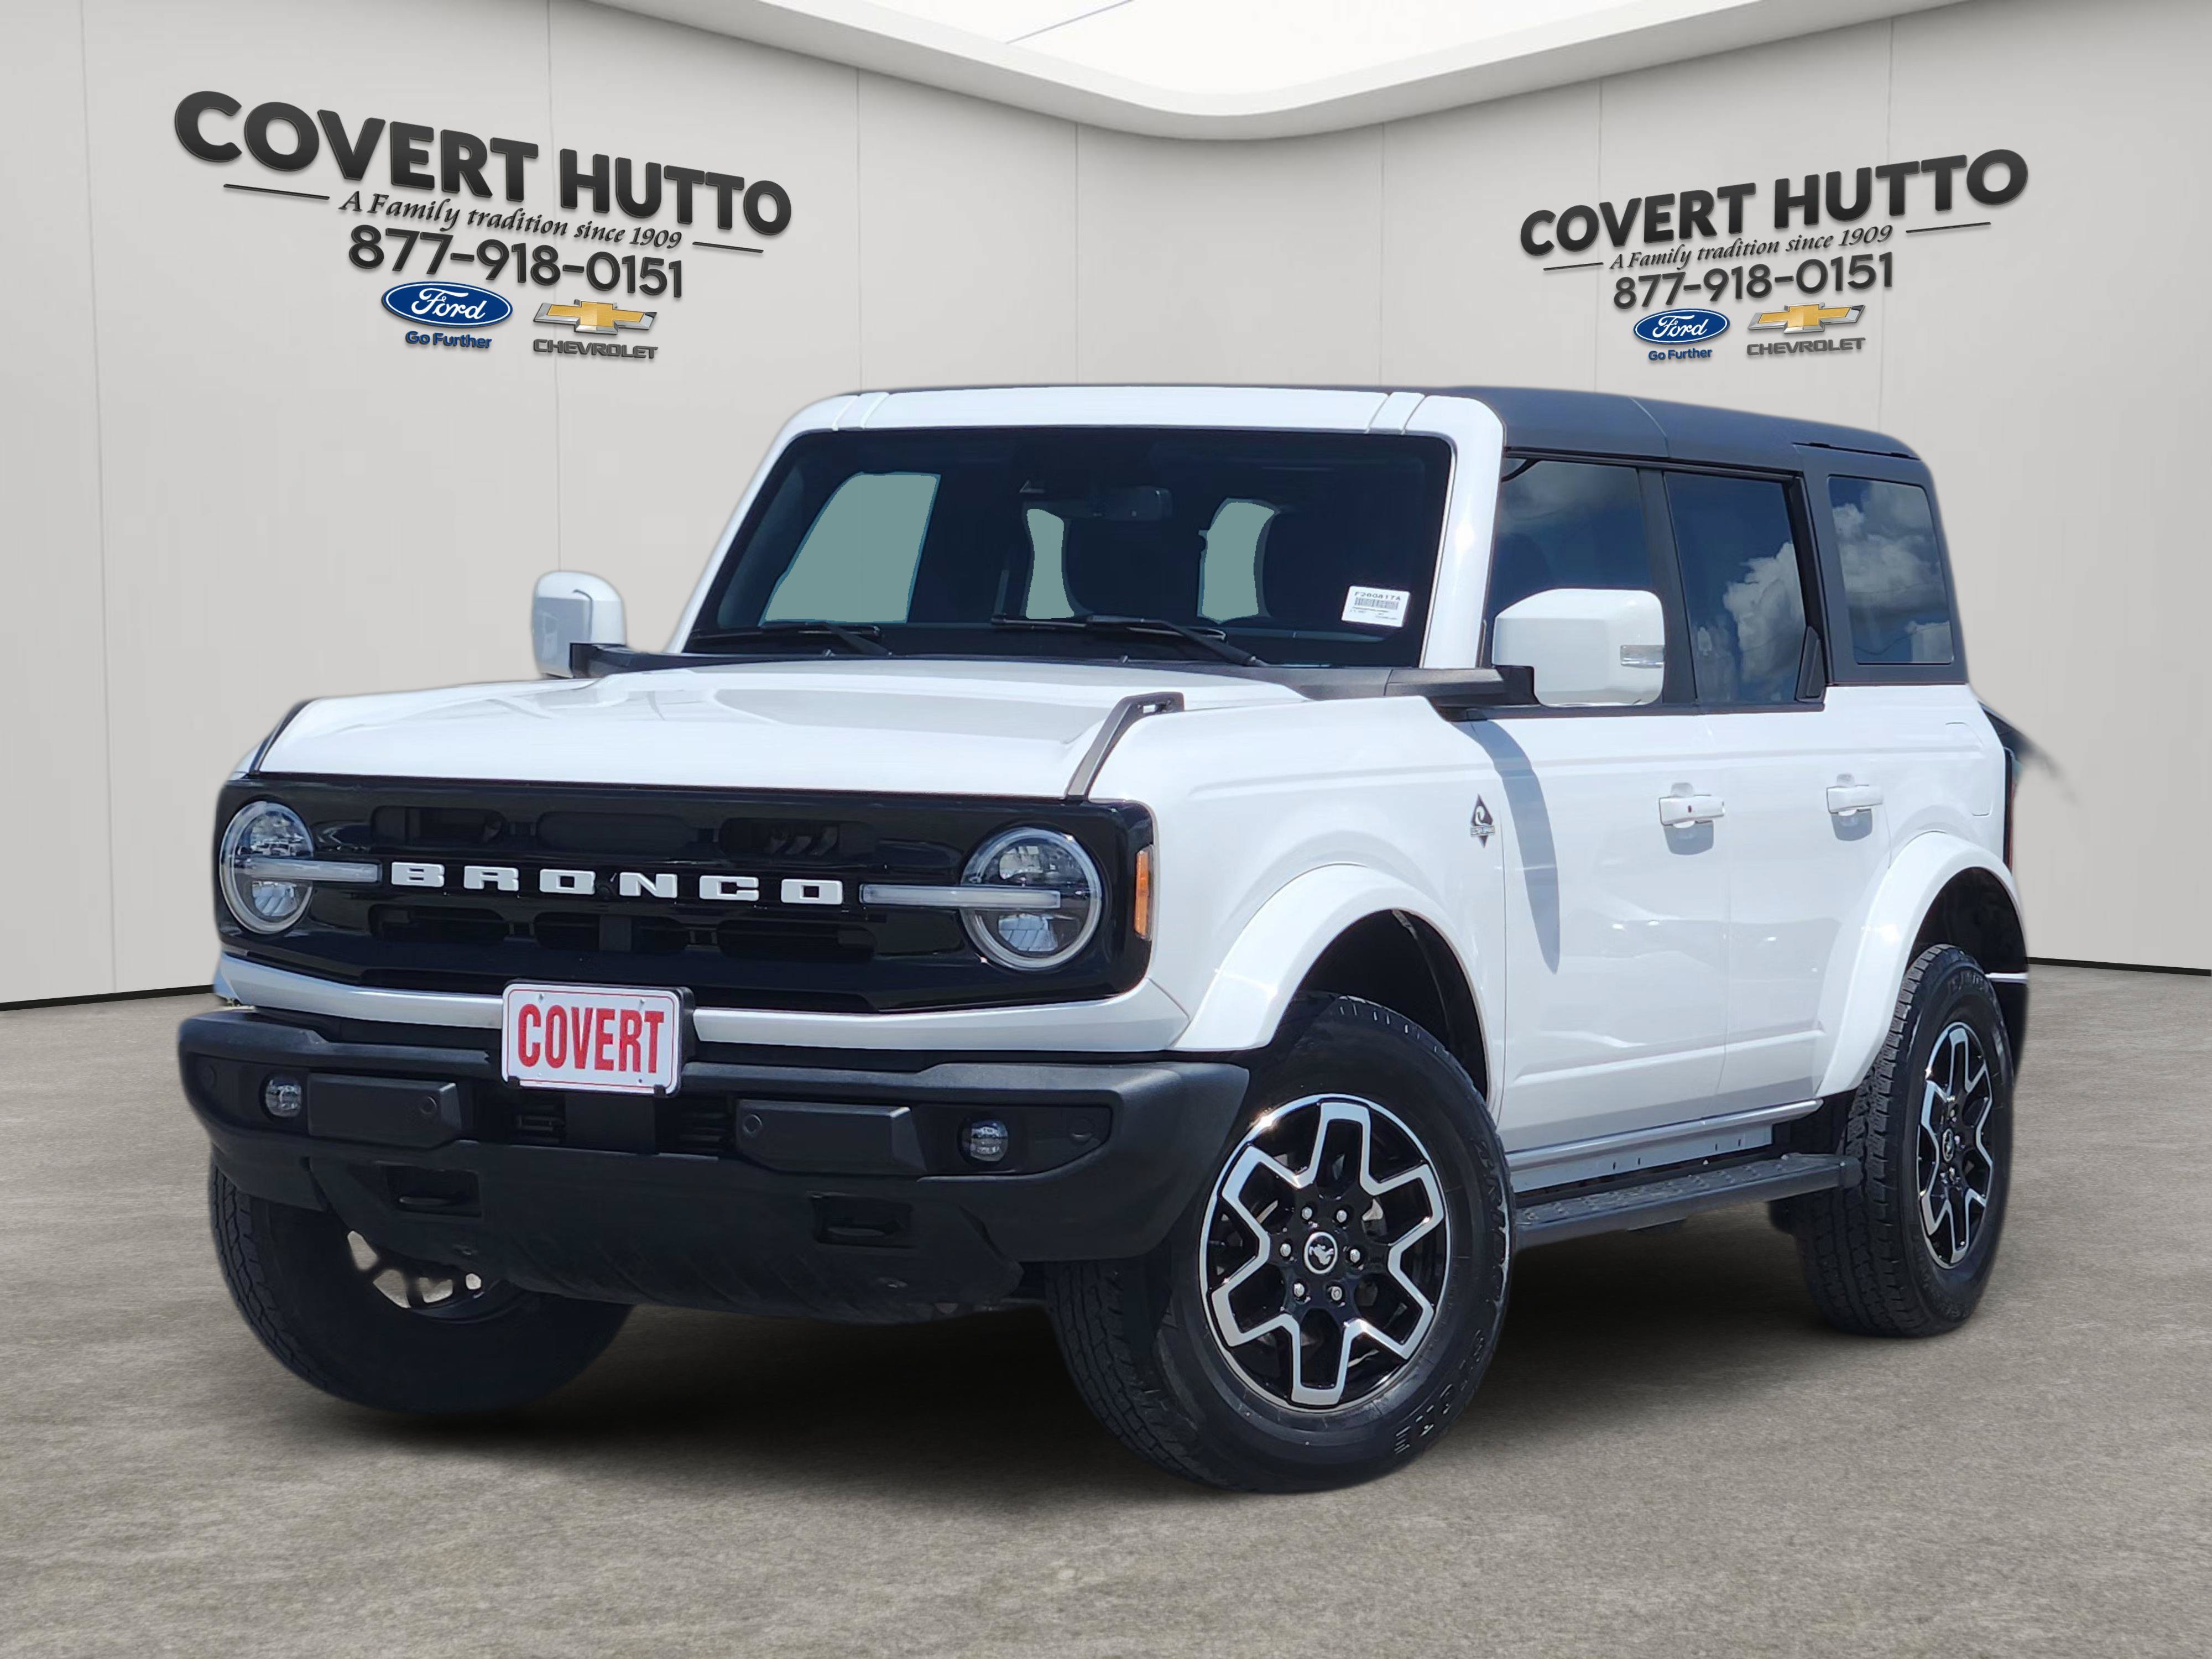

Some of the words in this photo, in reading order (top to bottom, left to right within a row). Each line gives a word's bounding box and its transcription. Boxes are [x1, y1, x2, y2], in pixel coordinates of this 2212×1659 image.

[174, 91, 539, 203] COVERT
[560, 148, 791, 236] HUTTO
[338, 191, 362, 212] A
[367, 194, 461, 232] Family
[467, 207, 568, 236] tradition
[573, 223, 625, 243] since
[629, 227, 682, 249] 1909
[1520, 182, 1756, 257] COVERT
[1774, 149, 2028, 229] HUTTO
[348, 225, 682, 299] 877-918-0151
[1609, 253, 1624, 270] A
[1627, 243, 1692, 270] Family
[1697, 237, 1780, 261] tradition
[1785, 235, 1834, 252] since
[1838, 225, 1893, 247] 1909
[1614, 252, 1892, 310] 877-918-0151
[411, 288, 487, 320] Ford
[1652, 314, 1709, 338] Ford
[405, 330, 431, 346] Go
[432, 333, 493, 349] Further
[533, 338, 659, 360] CHEVROLET
[1648, 350, 1666, 362] Go
[1667, 348, 1713, 361] Further
[1746, 337, 1866, 356] CHEVROLET
[391, 861, 843, 905] BRONCO
[518, 1004, 665, 1074] COVERT
